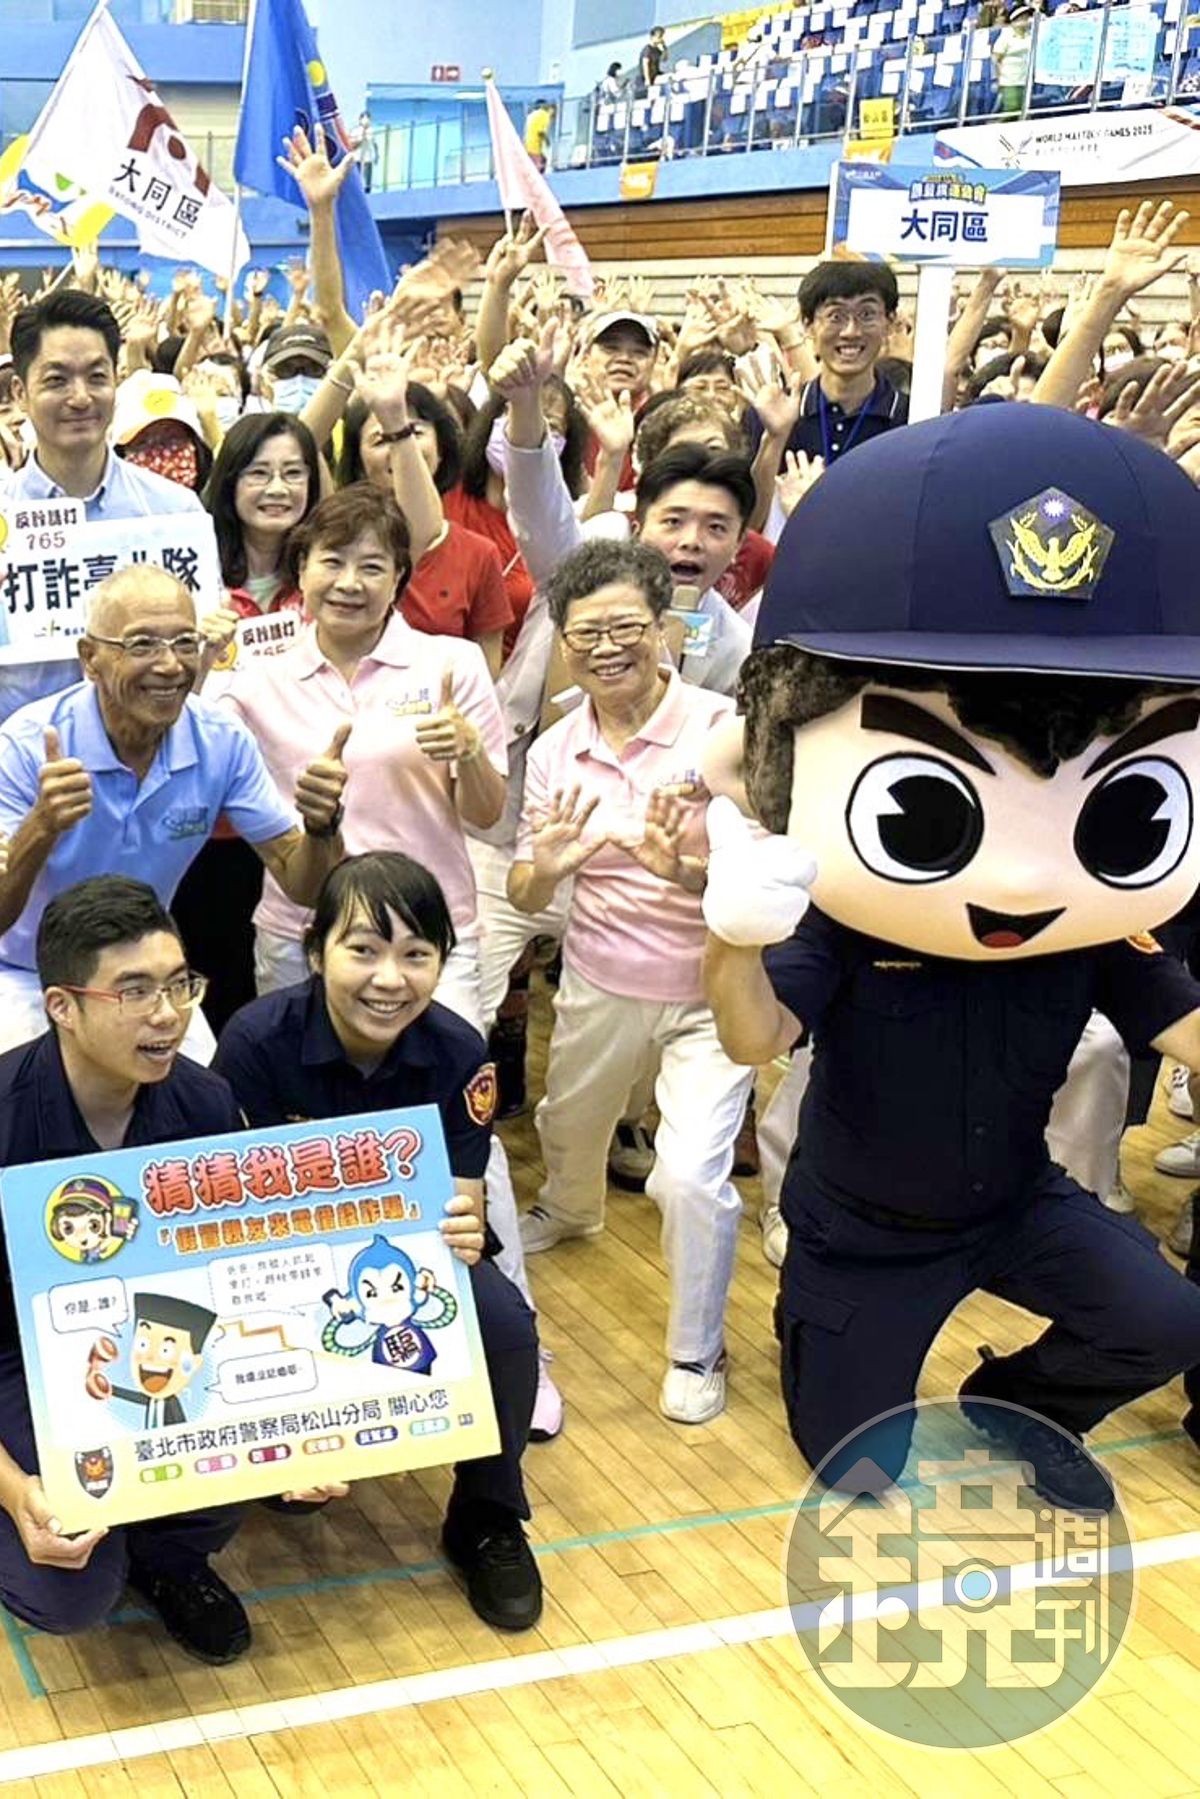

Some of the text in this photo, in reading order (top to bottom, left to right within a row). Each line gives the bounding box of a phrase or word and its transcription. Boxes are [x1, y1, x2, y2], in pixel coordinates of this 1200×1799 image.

[112, 158, 204, 230] 大同區
[901, 208, 989, 242] 大同區
[134, 1399, 382, 1462] 臺北市政府警察局松山分局
[387, 1388, 450, 1417] 關心您
